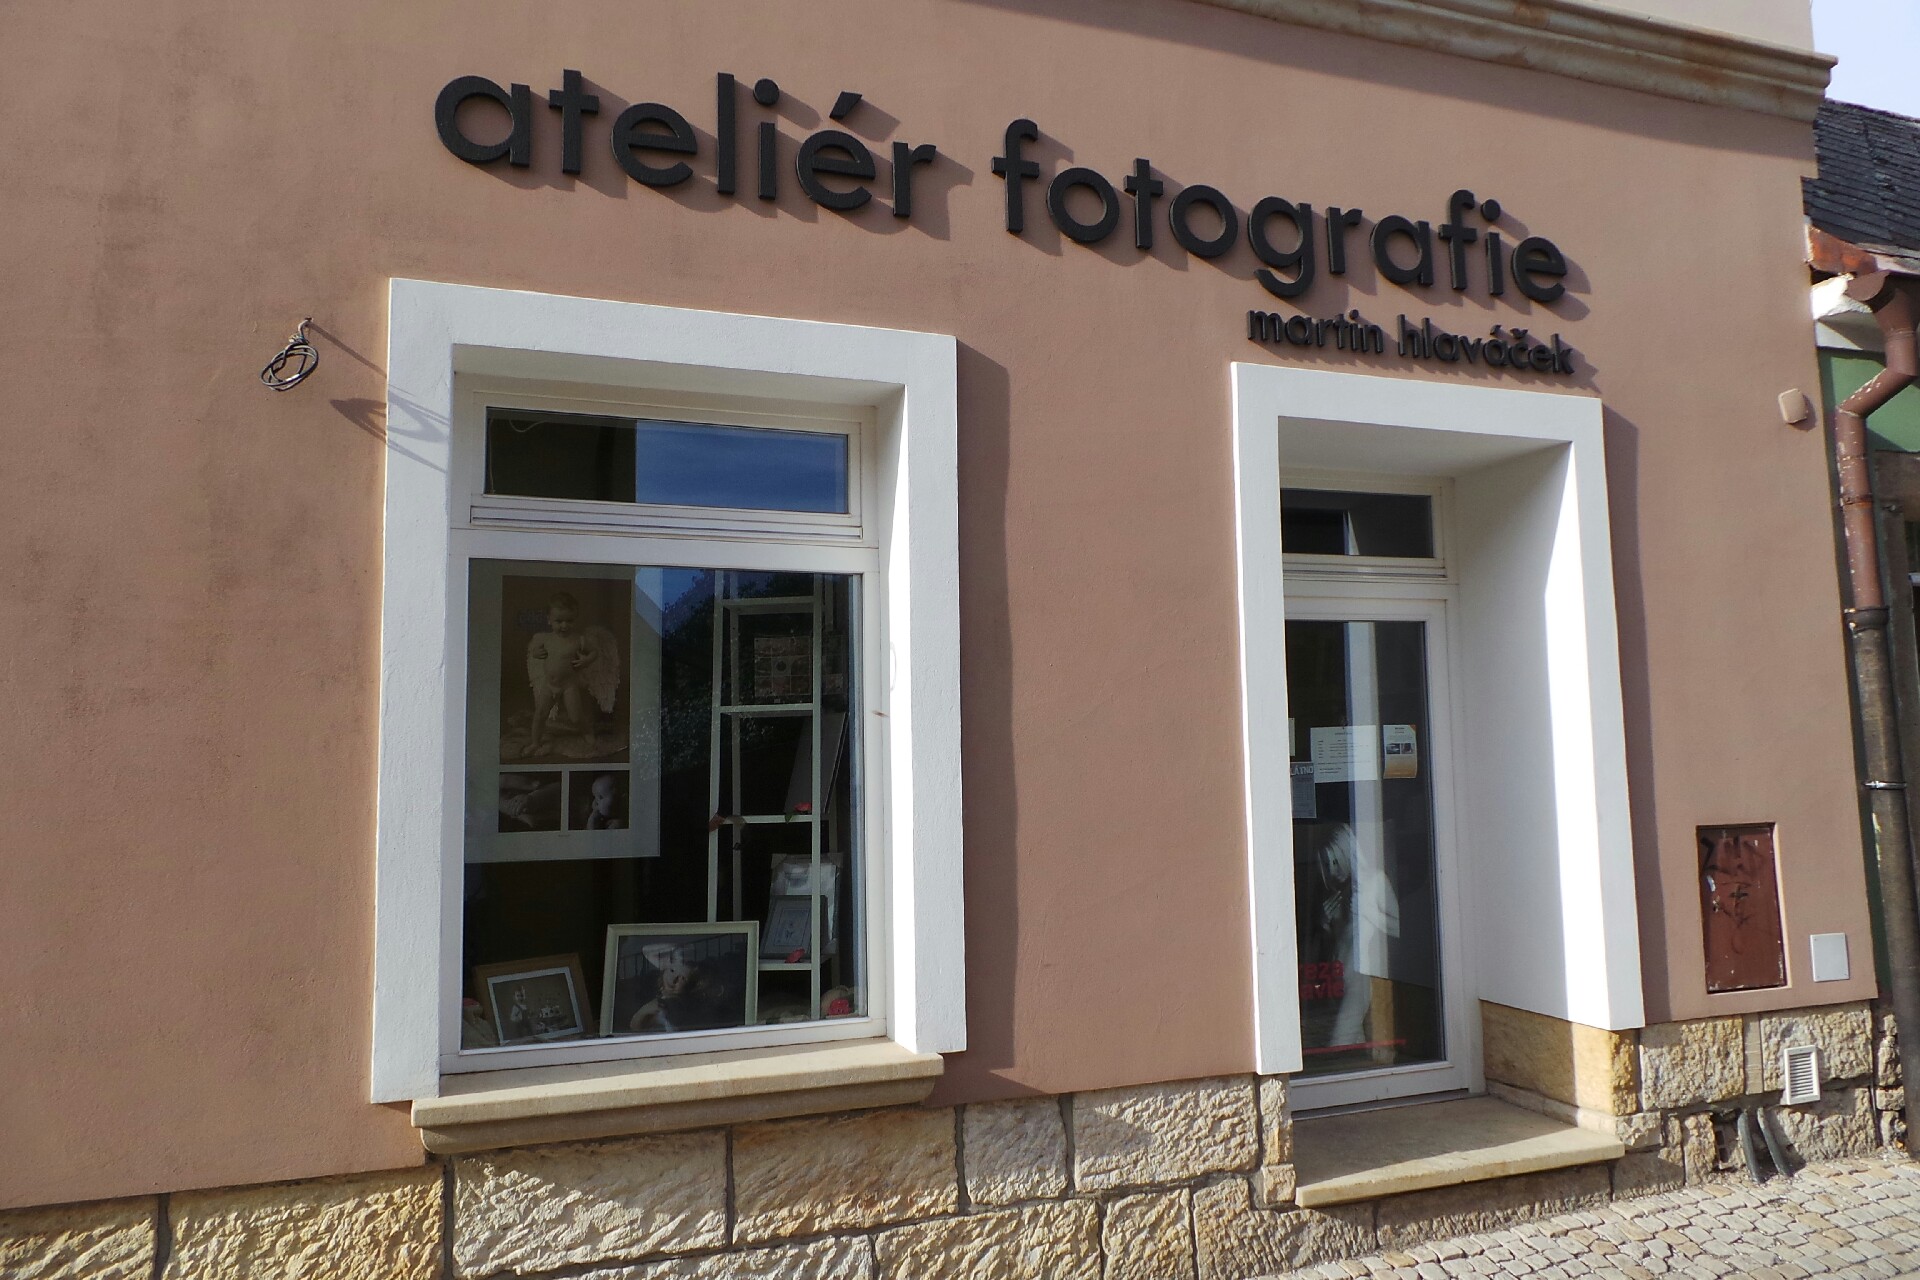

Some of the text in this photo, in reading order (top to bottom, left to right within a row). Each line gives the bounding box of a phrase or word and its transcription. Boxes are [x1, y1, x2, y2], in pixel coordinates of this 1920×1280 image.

[434, 68, 1567, 303] ateliér fotografie
[1247, 308, 1575, 375] martin hlaváček
